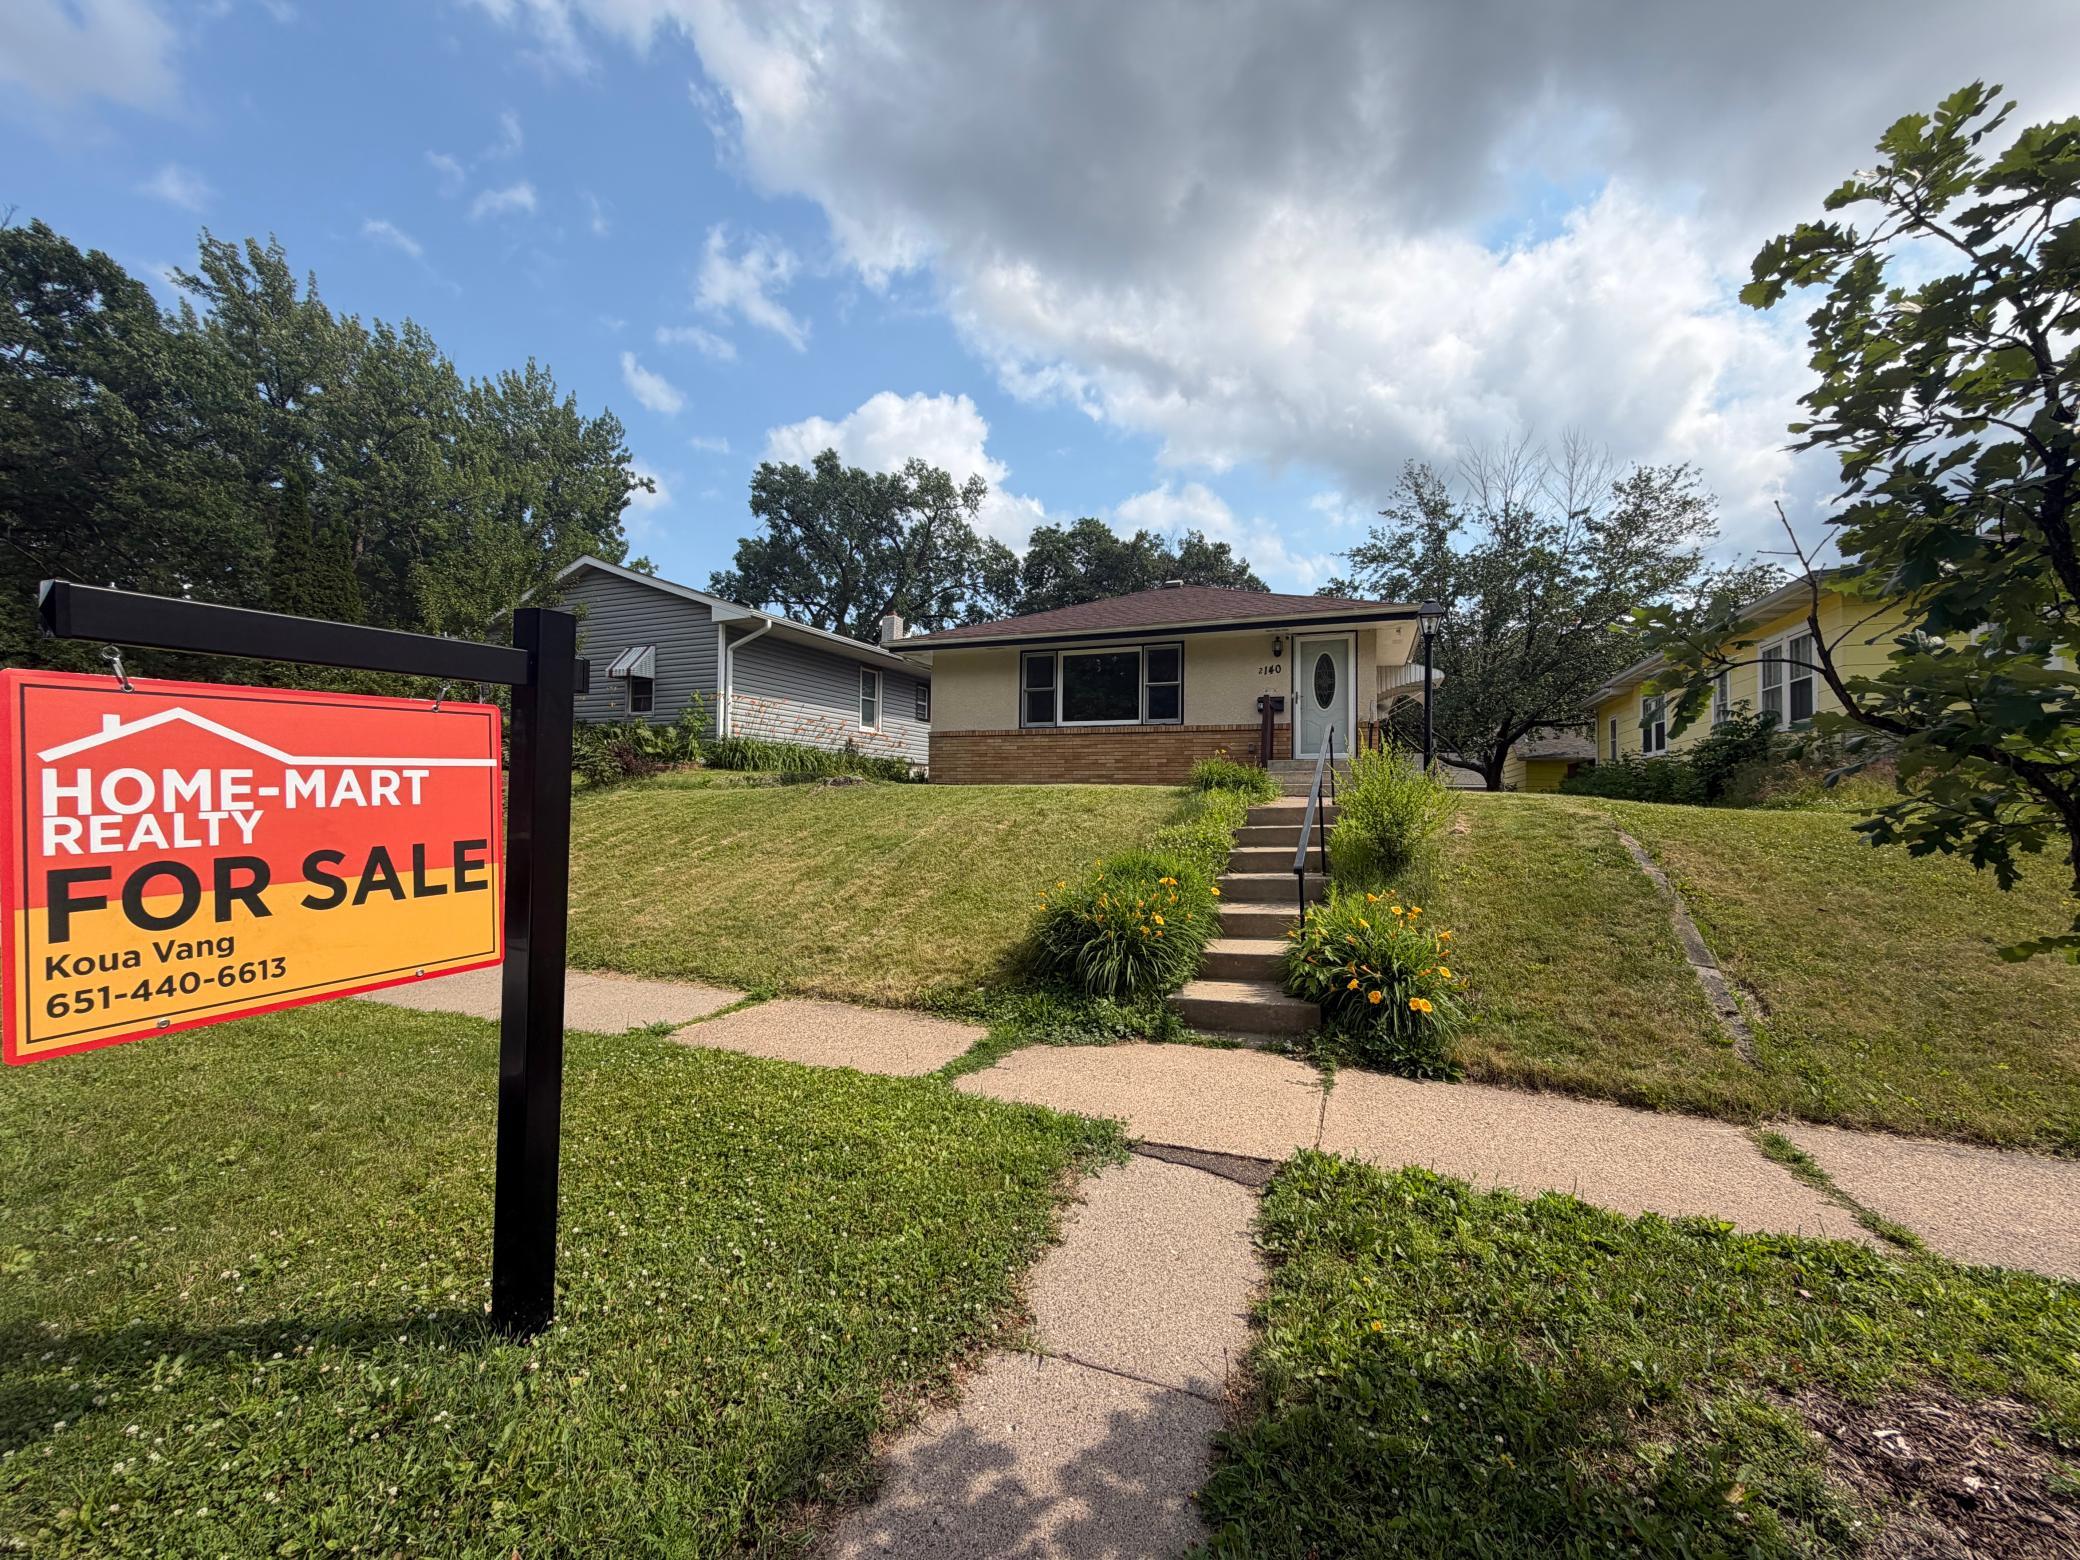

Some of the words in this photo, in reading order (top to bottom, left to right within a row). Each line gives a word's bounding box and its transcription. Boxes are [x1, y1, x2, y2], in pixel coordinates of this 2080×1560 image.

[1258, 664, 1282, 675] 2140
[42, 768, 430, 817] HOME-MART
[42, 809, 264, 857] REALTY
[47, 856, 273, 945] FOR
[300, 838, 489, 911] SALE
[45, 950, 141, 981] Koua
[153, 936, 235, 963] Vang
[46, 956, 287, 1019] 651-440-6613
